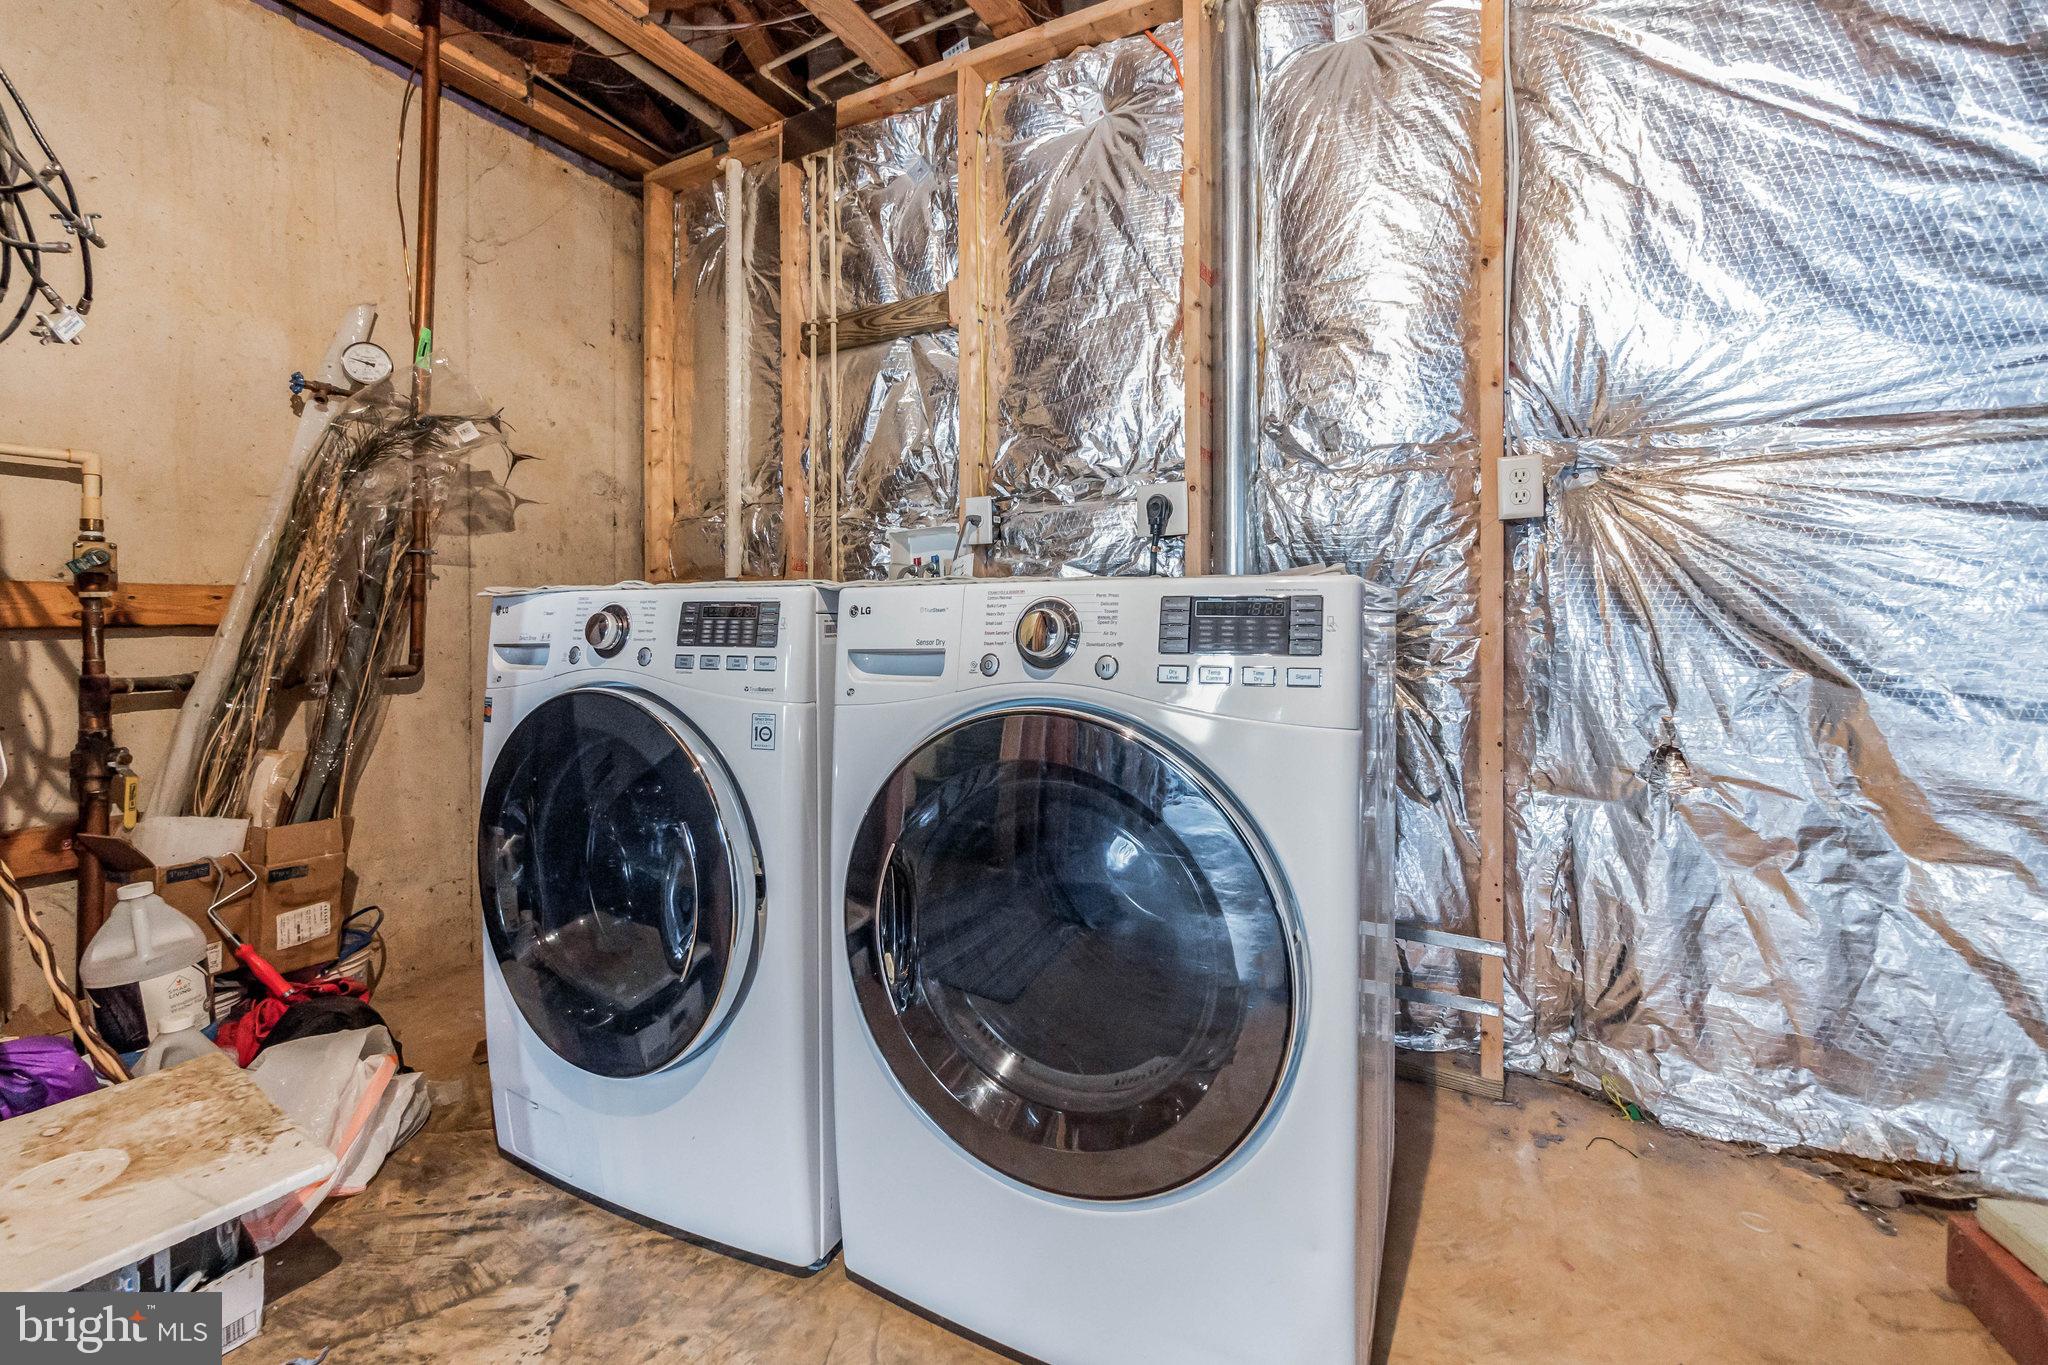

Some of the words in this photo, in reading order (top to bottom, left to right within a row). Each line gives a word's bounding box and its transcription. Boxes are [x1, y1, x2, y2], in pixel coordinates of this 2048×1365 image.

[860, 606, 872, 615] LG
[915, 639, 935, 647] Sensor
[935, 639, 946, 648] Dry
[1295, 673, 1312, 681] Signal
[754, 726, 773, 742] 10
